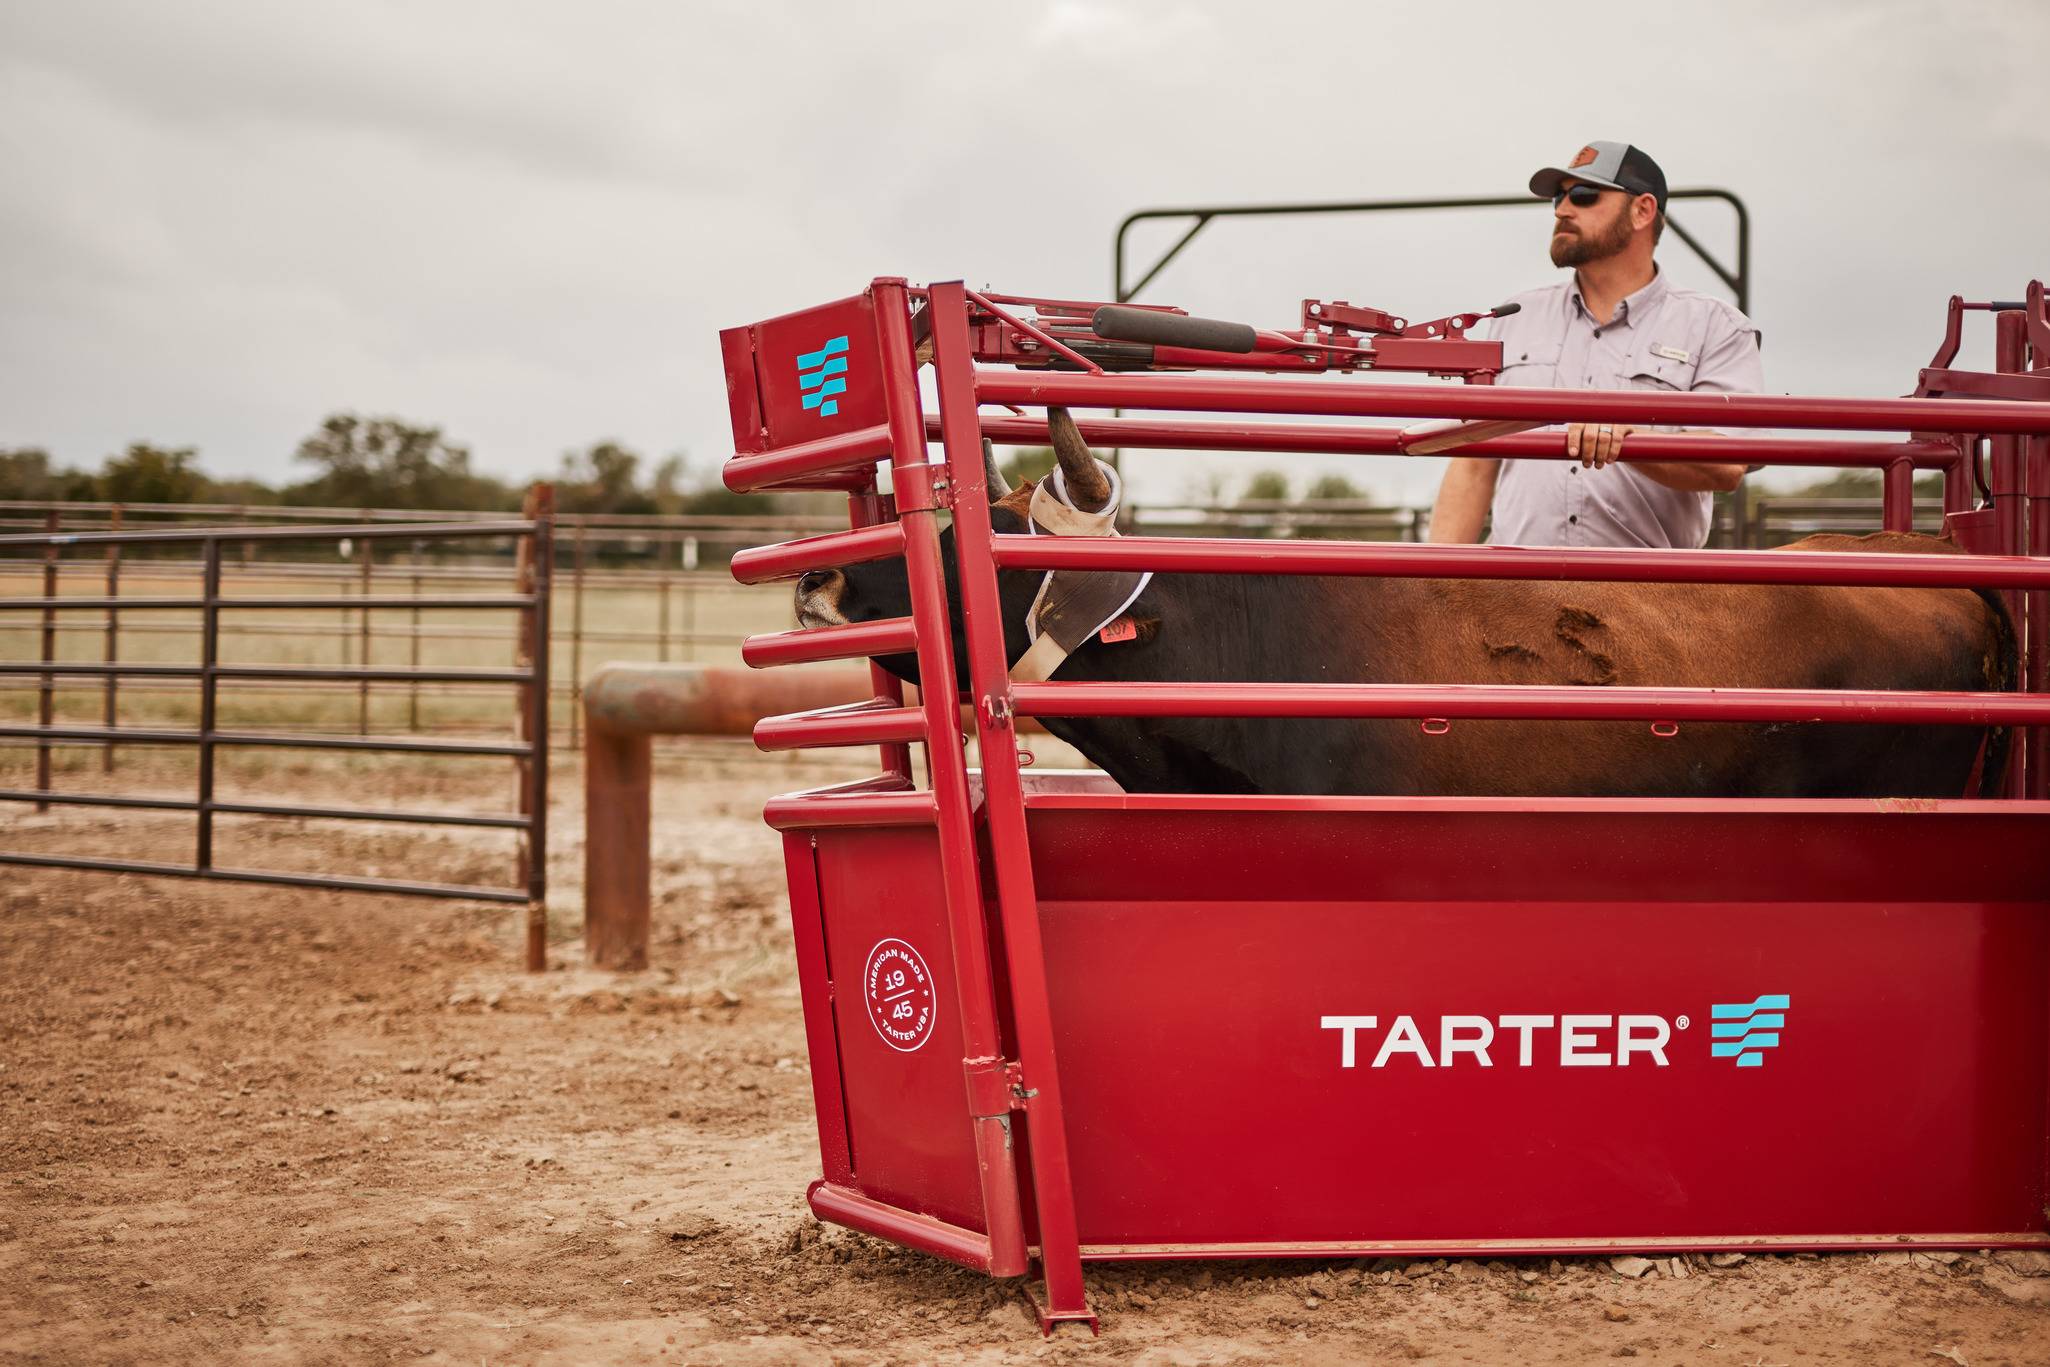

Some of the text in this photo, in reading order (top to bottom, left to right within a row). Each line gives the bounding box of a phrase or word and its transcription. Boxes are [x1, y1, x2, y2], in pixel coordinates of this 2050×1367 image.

[871, 949, 925, 999] AMERICAN MADE
[885, 970, 905, 991] 19
[892, 1000, 914, 1020] 45
[881, 1018, 917, 1041] TARTER
